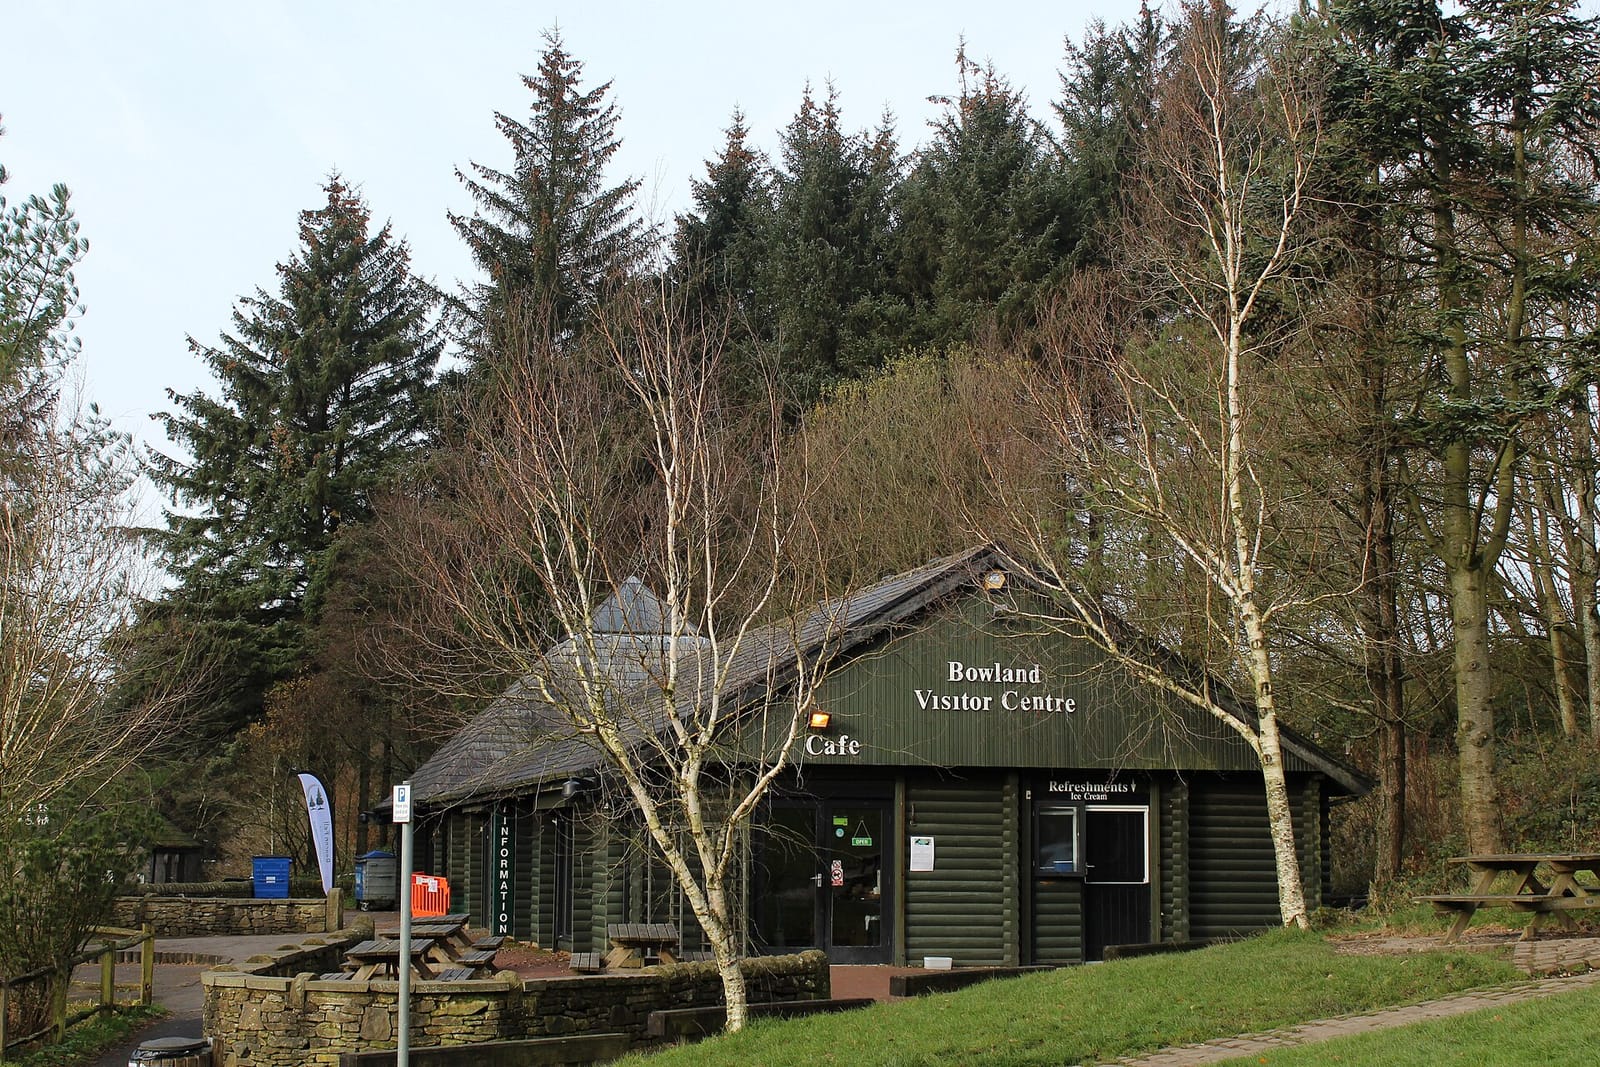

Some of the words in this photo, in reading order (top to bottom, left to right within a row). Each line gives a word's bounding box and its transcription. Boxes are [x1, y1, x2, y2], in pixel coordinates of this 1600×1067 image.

[947, 661, 1042, 684] Bowland
[913, 689, 993, 712] Visitor
[1001, 689, 1077, 713] Centre
[805, 735, 862, 757] Cafe
[399, 789, 405, 802] P
[1049, 781, 1128, 793] Refreshments
[1070, 791, 1082, 801] Ice
[1083, 791, 1108, 801] Cream
[855, 838, 869, 846] OPEN
[499, 816, 510, 934] INFORMATION
